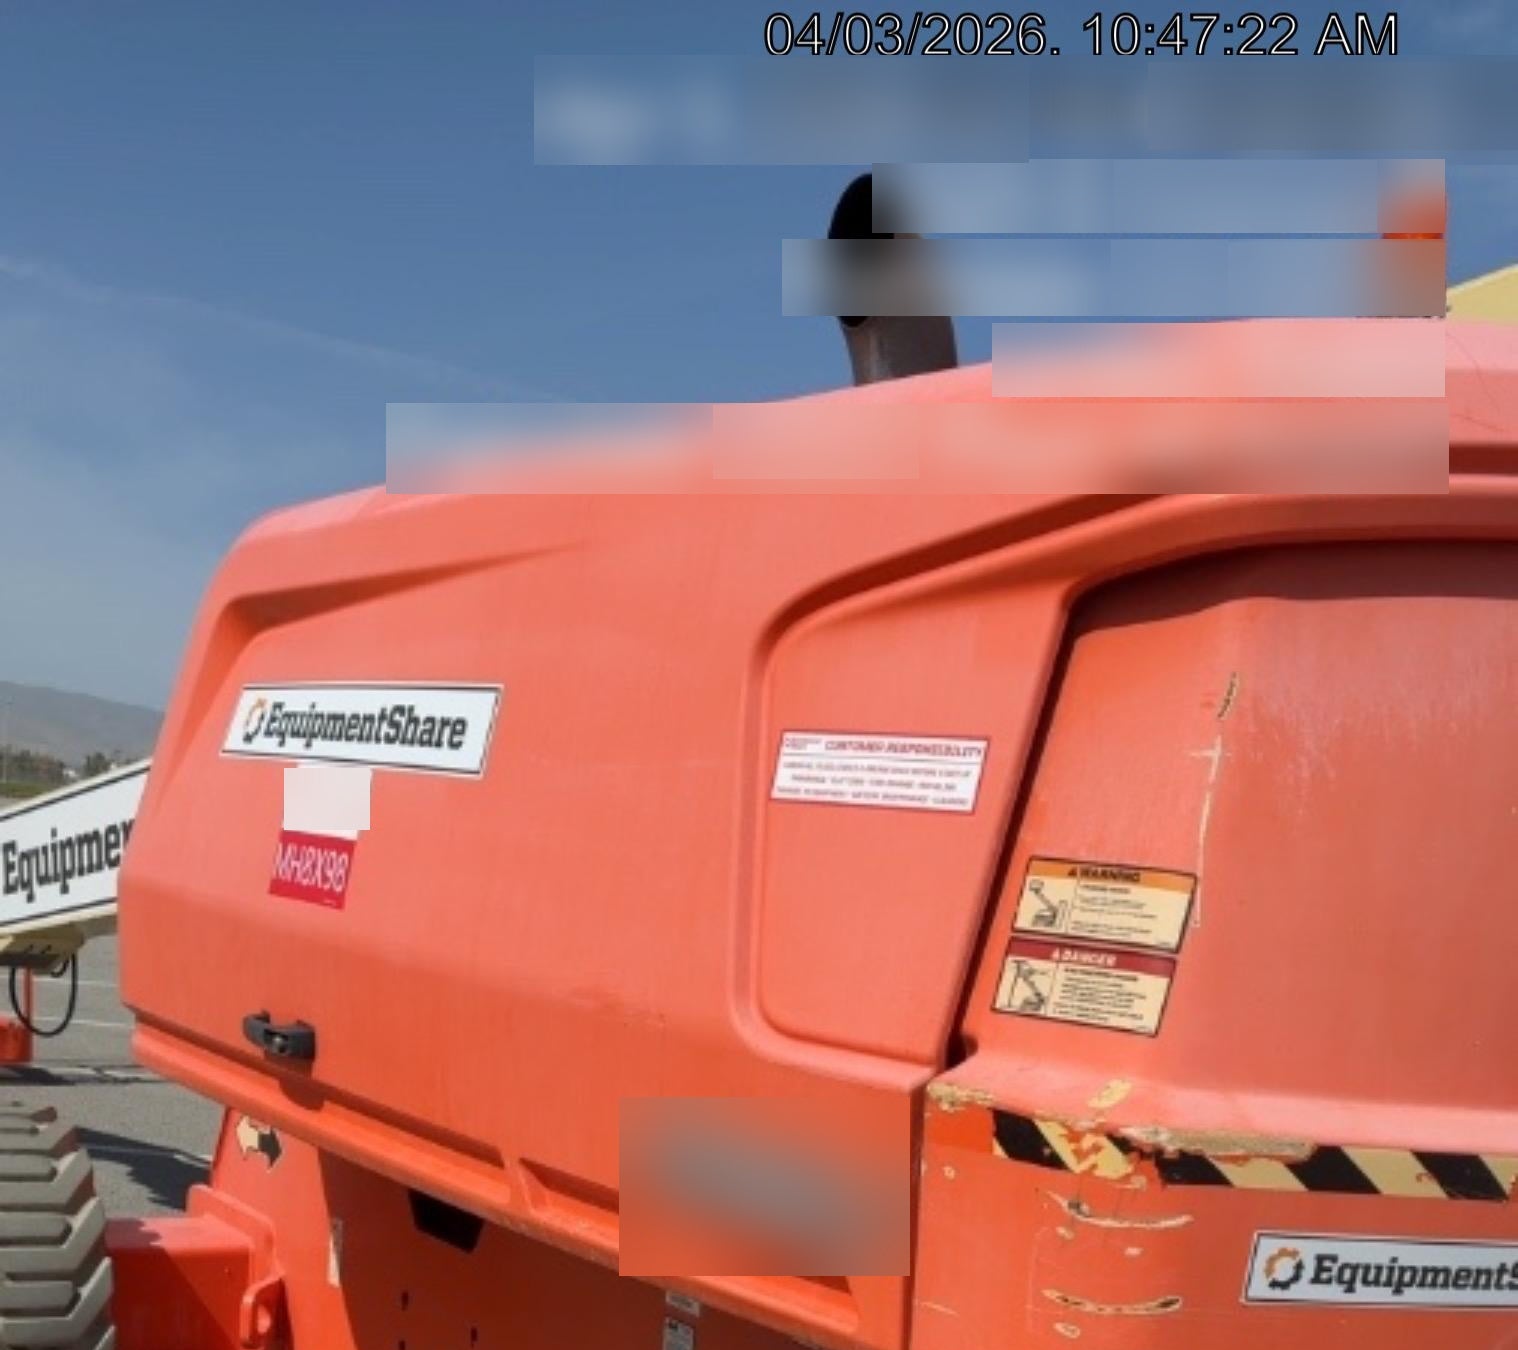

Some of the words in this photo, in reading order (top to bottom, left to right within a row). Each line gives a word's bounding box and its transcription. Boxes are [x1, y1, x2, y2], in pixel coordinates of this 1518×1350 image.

[264, 702, 467, 750] EquipmentShare
[1080, 868, 1141, 883] WARNING
[1062, 949, 1117, 967] DANGER
